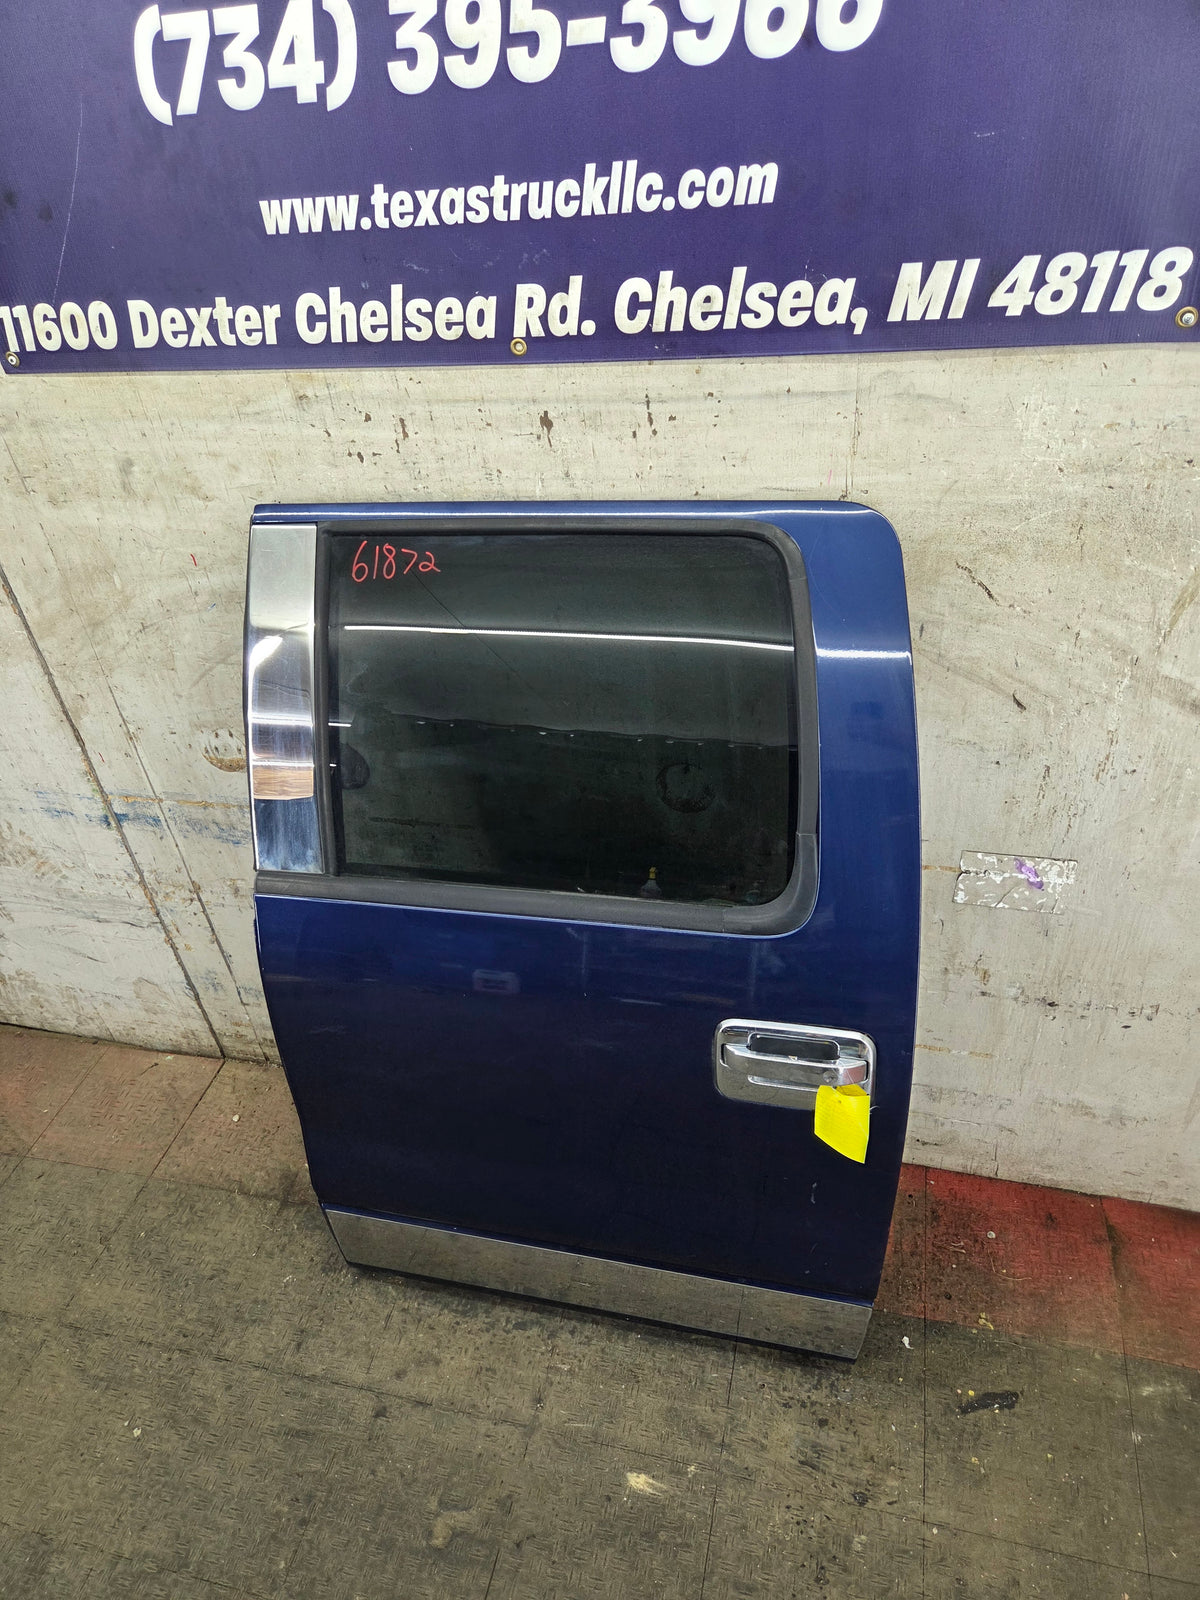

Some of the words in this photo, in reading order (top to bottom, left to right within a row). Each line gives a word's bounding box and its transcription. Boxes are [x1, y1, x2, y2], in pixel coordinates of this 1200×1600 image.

[133, 0, 358, 127] (734)
[258, 159, 779, 236] www.texastruckllc.com
[0, 300, 118, 353] 11600
[127, 296, 282, 349] Dexter
[295, 283, 497, 343] Chelsea
[513, 275, 597, 338] Rd.
[614, 266, 869, 335] Chelsea,
[887, 257, 982, 322] MI
[988, 246, 1194, 317] 48118
[352, 540, 441, 582] 61872
